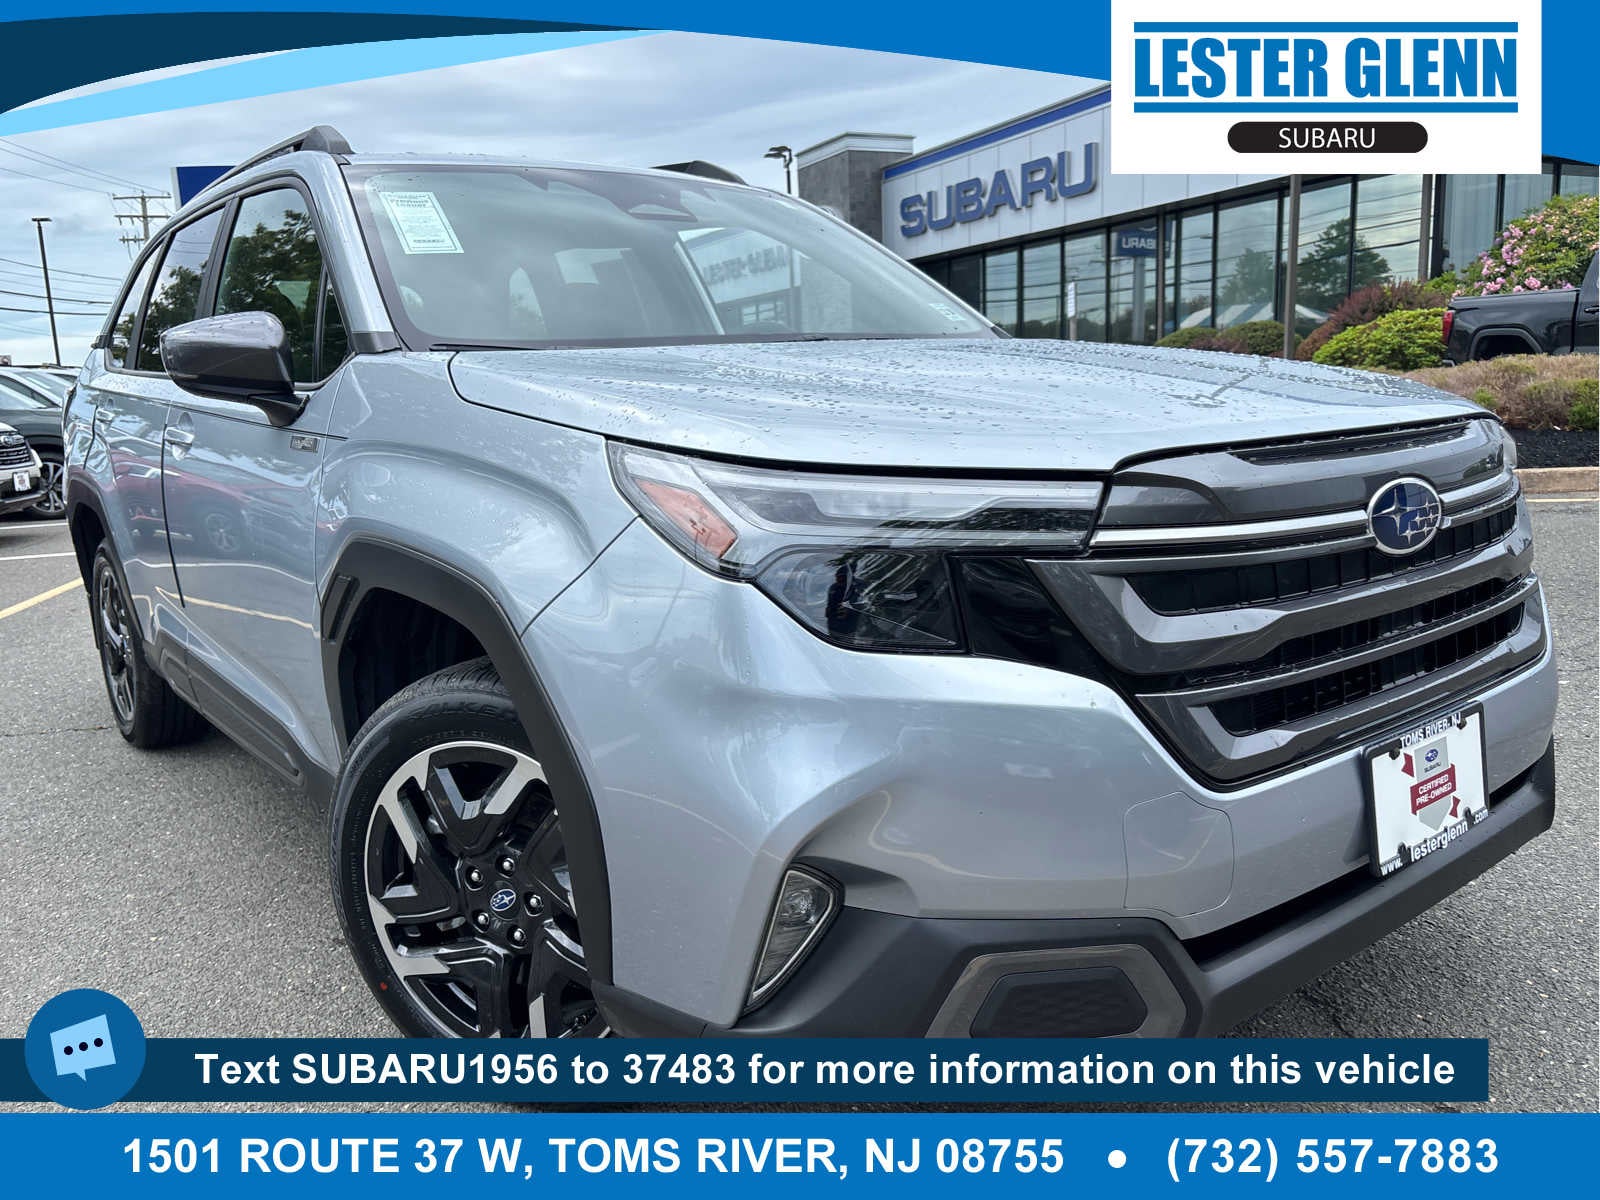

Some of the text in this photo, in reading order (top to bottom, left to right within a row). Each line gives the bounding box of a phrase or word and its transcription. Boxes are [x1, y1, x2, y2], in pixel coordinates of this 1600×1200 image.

[900, 142, 1099, 238] SUBARU
[1400, 729, 1425, 749] TOMS
[1452, 711, 1462, 728] NJ
[1416, 782, 1452, 806] PRE-OWNED
[1418, 774, 1449, 795] CERTIFIED
[1380, 856, 1403, 876] www.
[1410, 820, 1468, 862] lesterglenn
